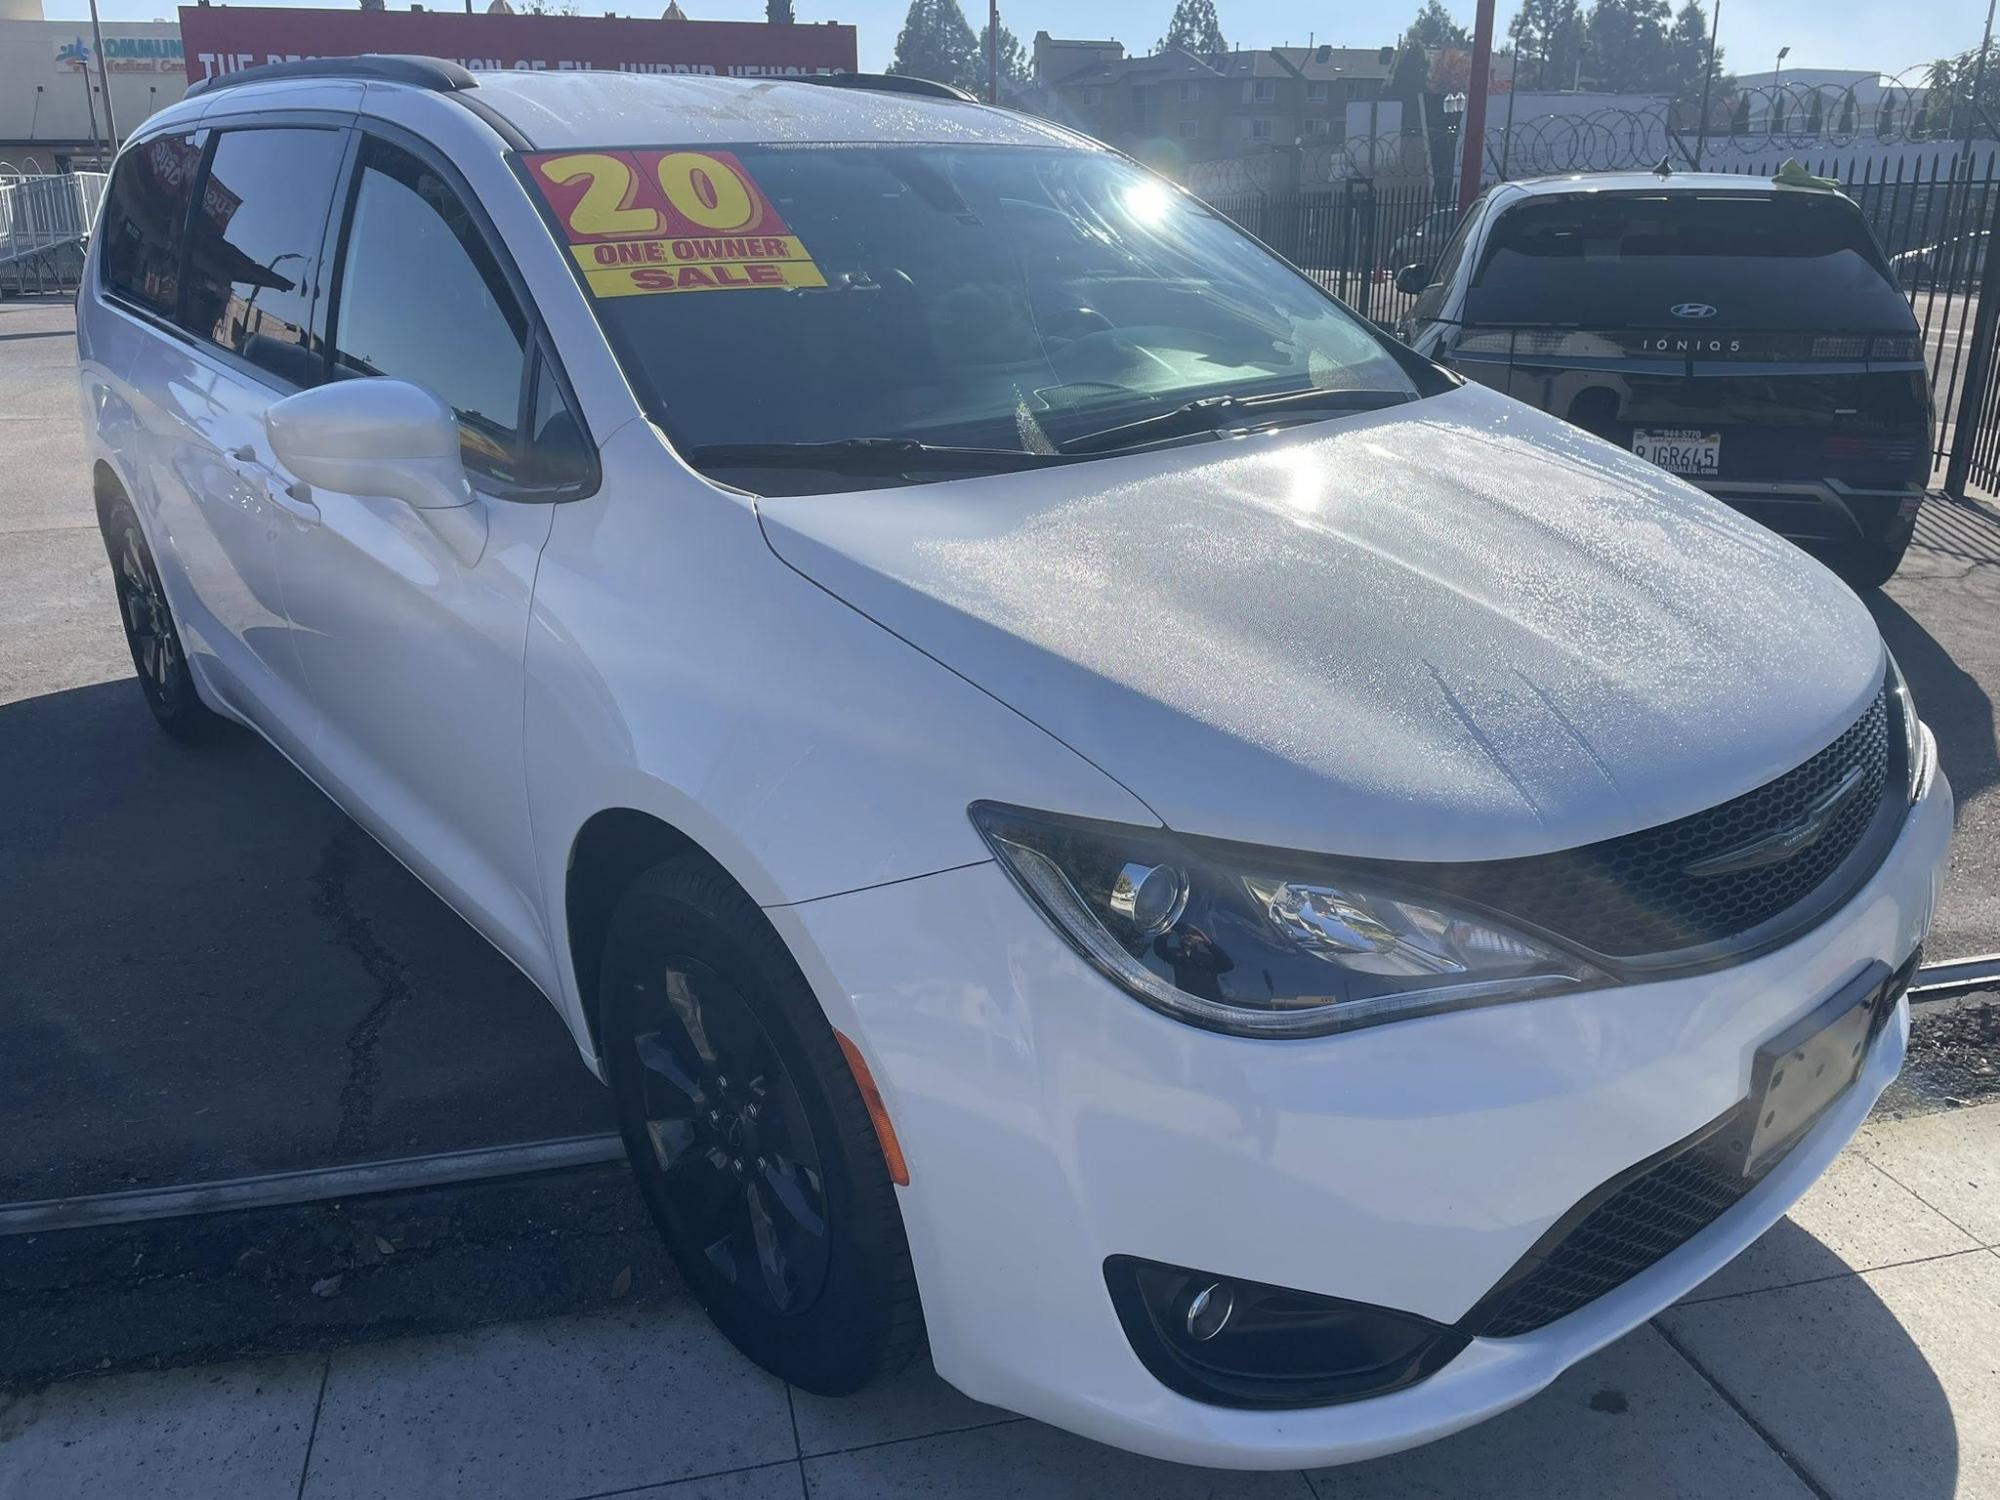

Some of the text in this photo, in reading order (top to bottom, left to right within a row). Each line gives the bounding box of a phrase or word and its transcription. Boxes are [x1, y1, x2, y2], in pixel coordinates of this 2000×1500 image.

[540, 152, 764, 237] 20
[594, 237, 791, 266] ONE OWNER
[630, 264, 789, 291] SALE
